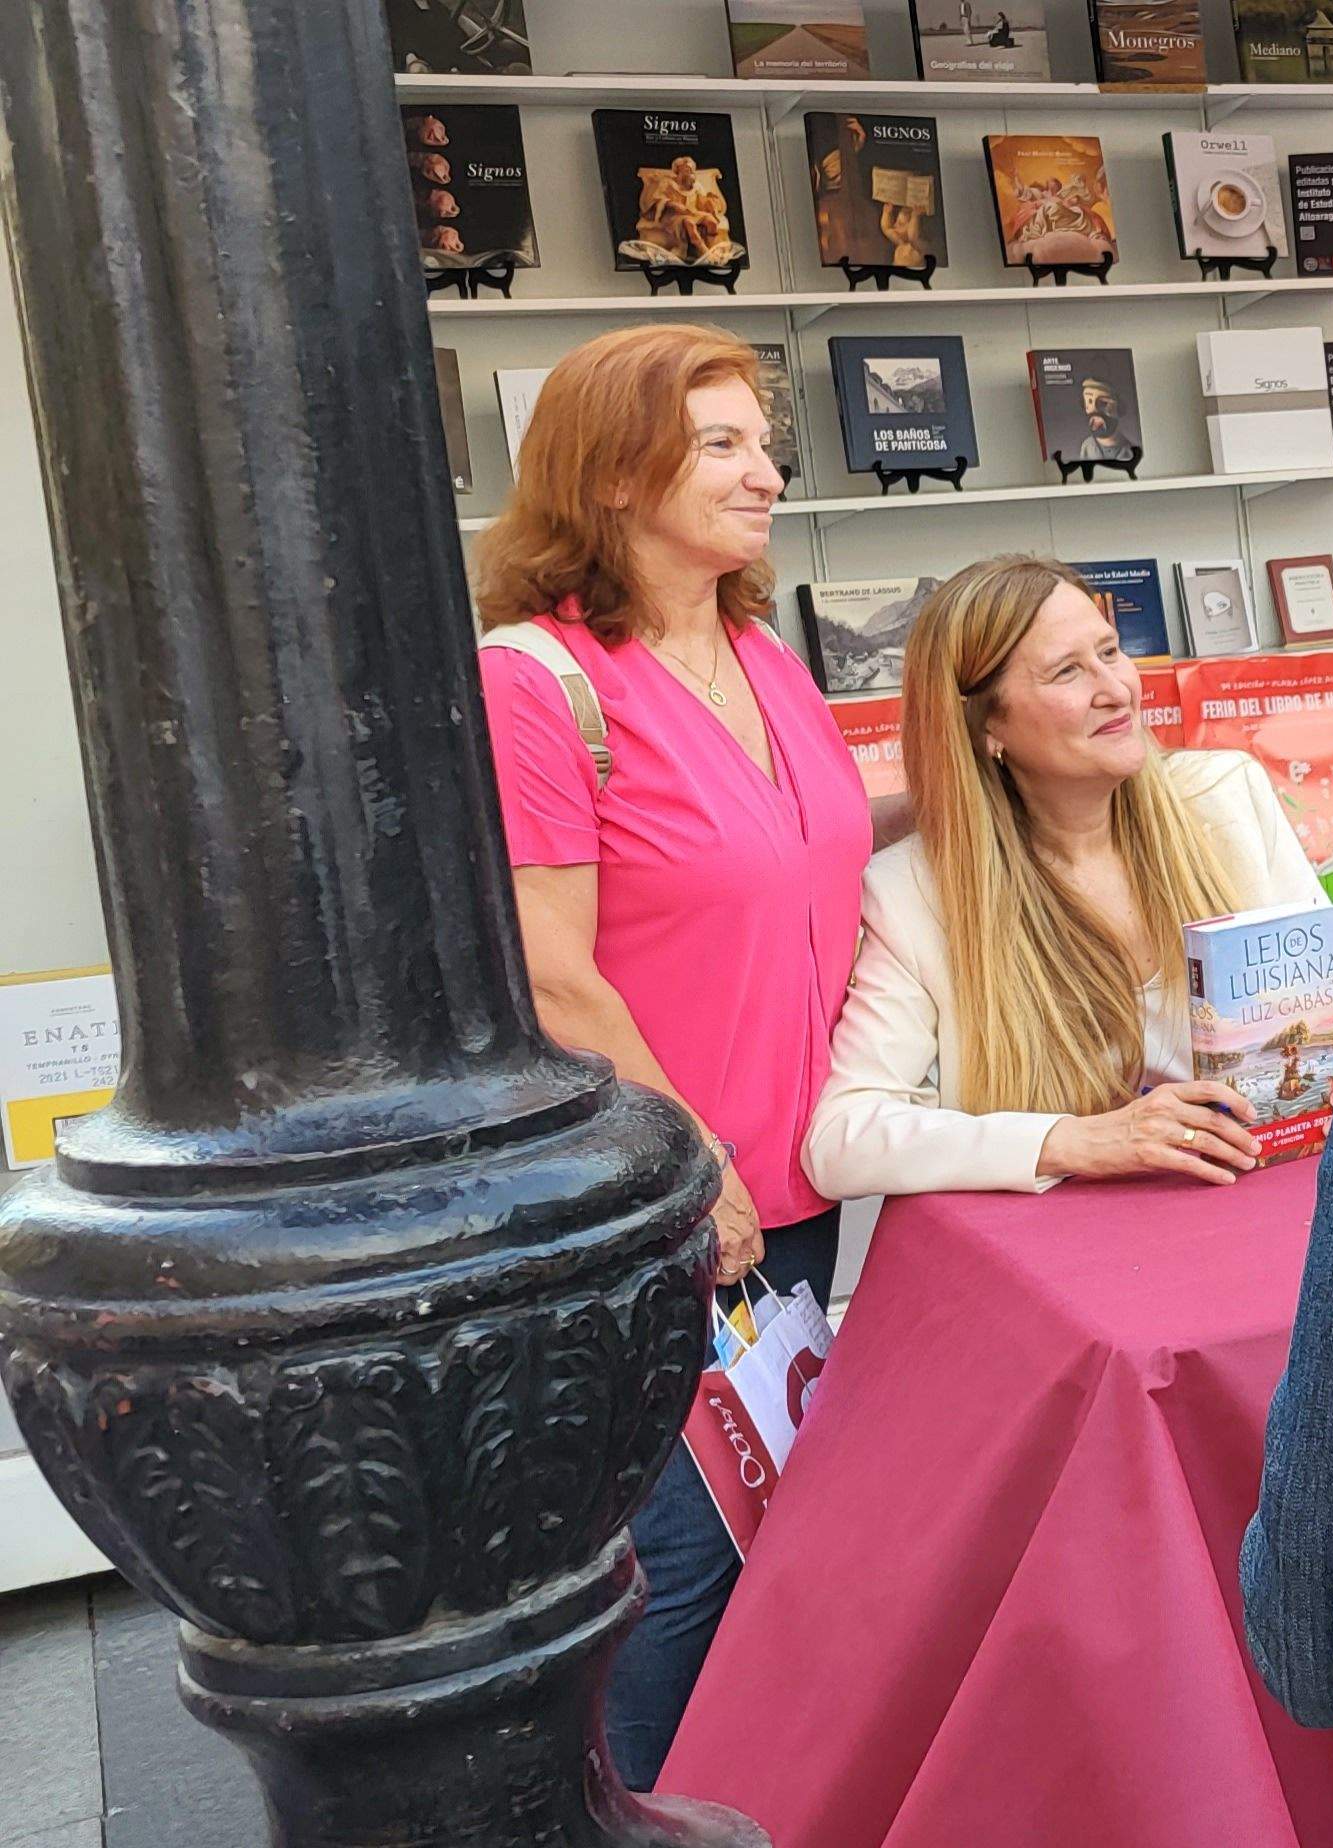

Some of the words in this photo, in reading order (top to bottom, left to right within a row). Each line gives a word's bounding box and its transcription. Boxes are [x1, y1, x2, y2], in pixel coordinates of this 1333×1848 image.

[1109, 31, 1195, 54] Monegros
[1250, 43, 1300, 56] Mediano
[643, 115, 697, 136] Signos
[873, 125, 931, 141] SIGNOS
[1201, 140, 1248, 151] Orwell
[467, 163, 522, 182] Signos
[1296, 177, 1329, 187] editadas
[1298, 201, 1308, 210] de
[1254, 378, 1288, 392] Signos
[874, 430, 894, 441] LOS
[896, 427, 930, 441] BAÑOS
[875, 441, 889, 451] DE
[891, 440, 947, 451] PANTICOSA
[820, 589, 860, 598] BERTRAND
[873, 587, 901, 595] LASSUS
[1202, 699, 1236, 719] FERIA
[1240, 697, 1263, 716] DEL
[1265, 694, 1303, 714] LIBRO
[1304, 692, 1322, 710] DE
[1244, 923, 1324, 967] LEJOS
[1290, 936, 1303, 948] DE
[1241, 1005, 1273, 1026] LUZ
[1278, 985, 1333, 1017] GABÁS
[26, 1056, 91, 1070] TEMPRANILLO
[40, 1072, 68, 1084] 2021
[1275, 1121, 1312, 1137] PLANETA
